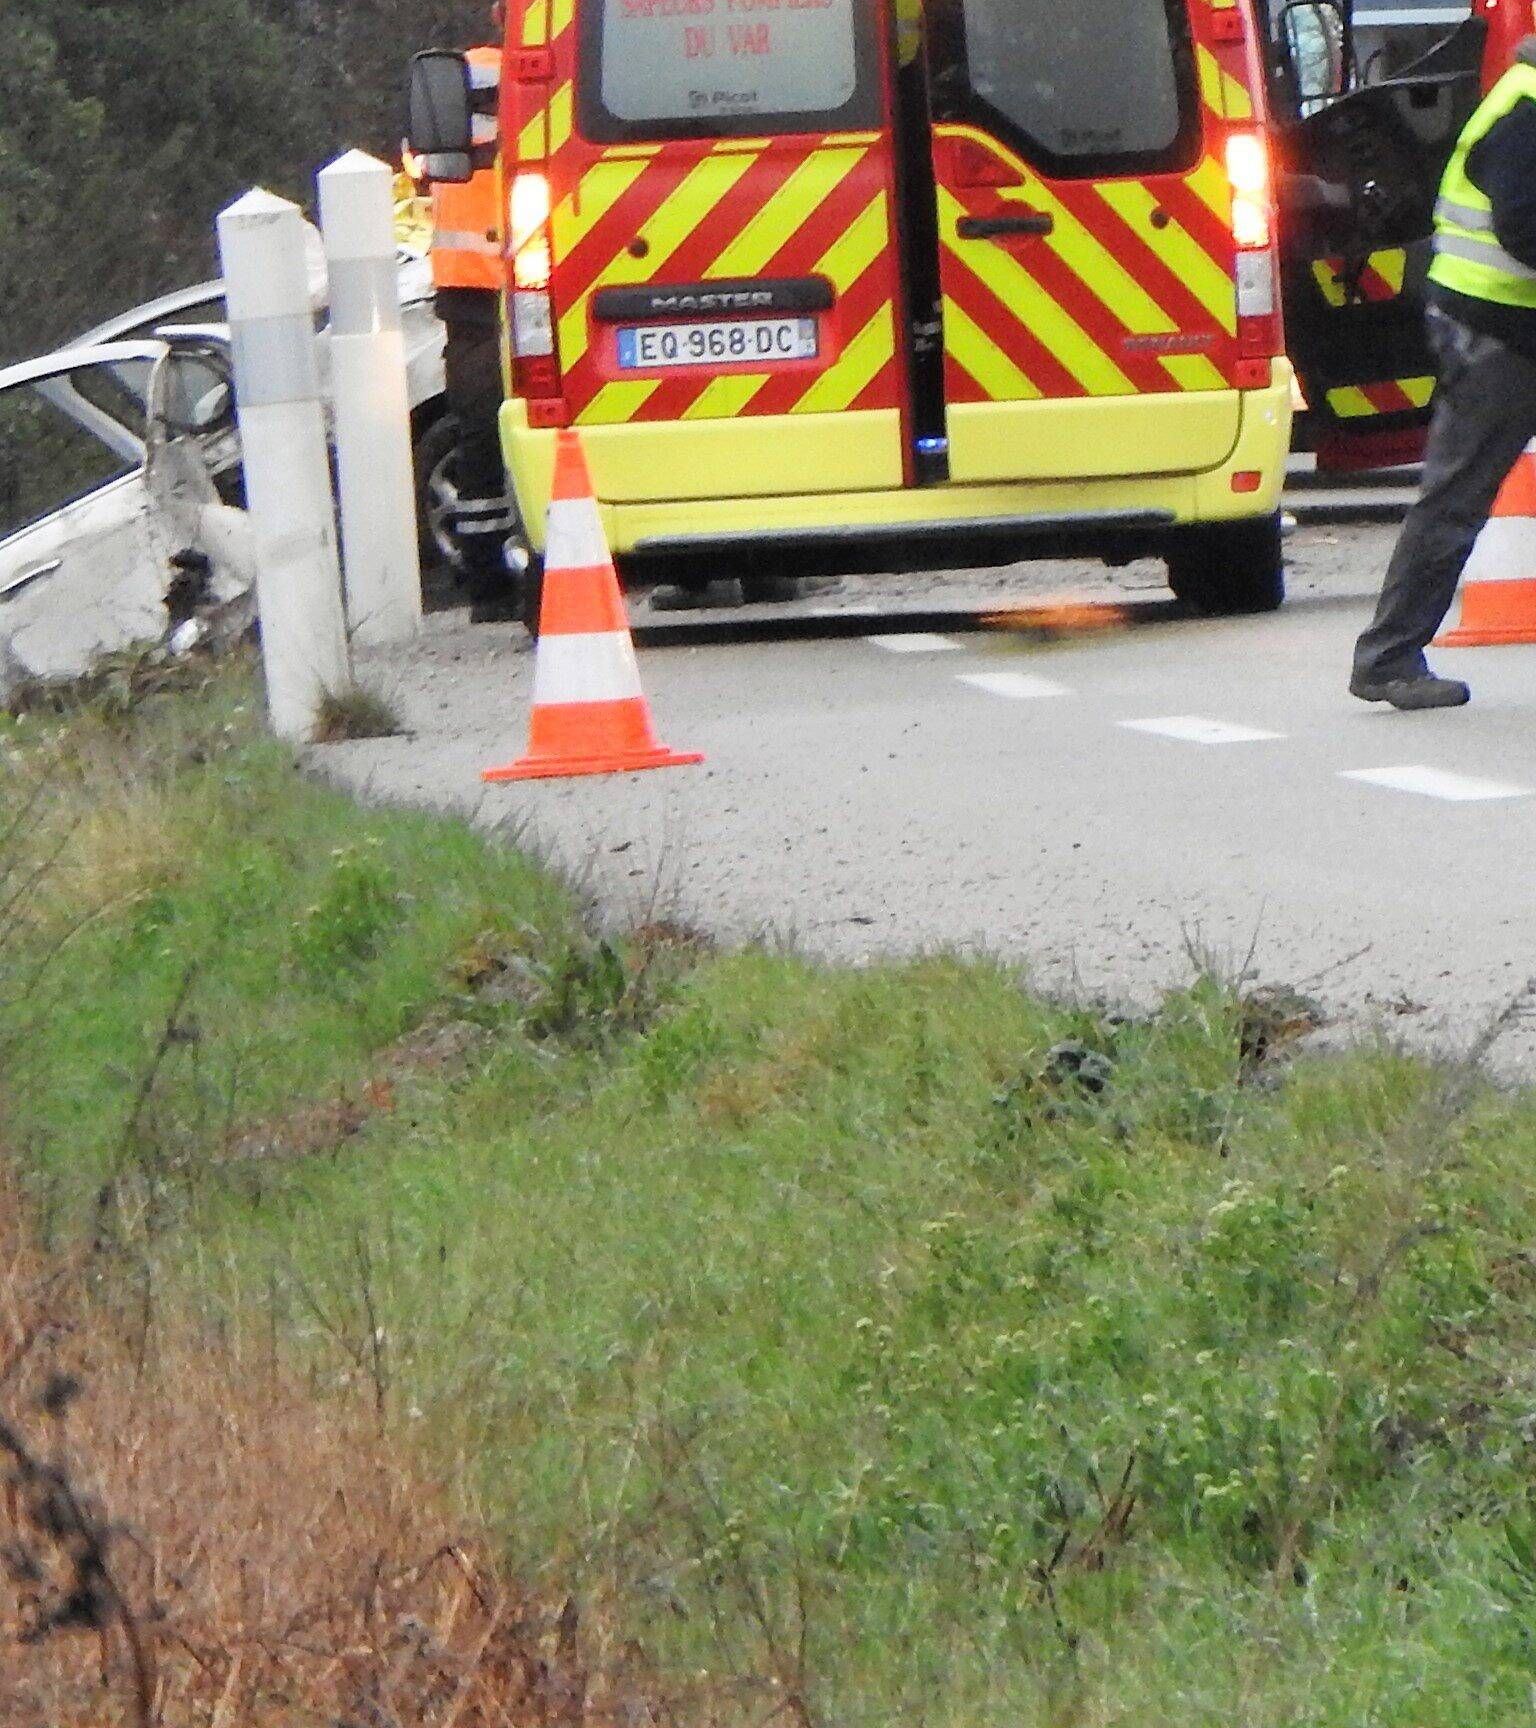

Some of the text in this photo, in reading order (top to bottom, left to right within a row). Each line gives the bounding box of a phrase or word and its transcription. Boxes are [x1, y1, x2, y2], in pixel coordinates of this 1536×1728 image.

[684, 23, 770, 58] DU VAR
[652, 291, 772, 312] MASTER
